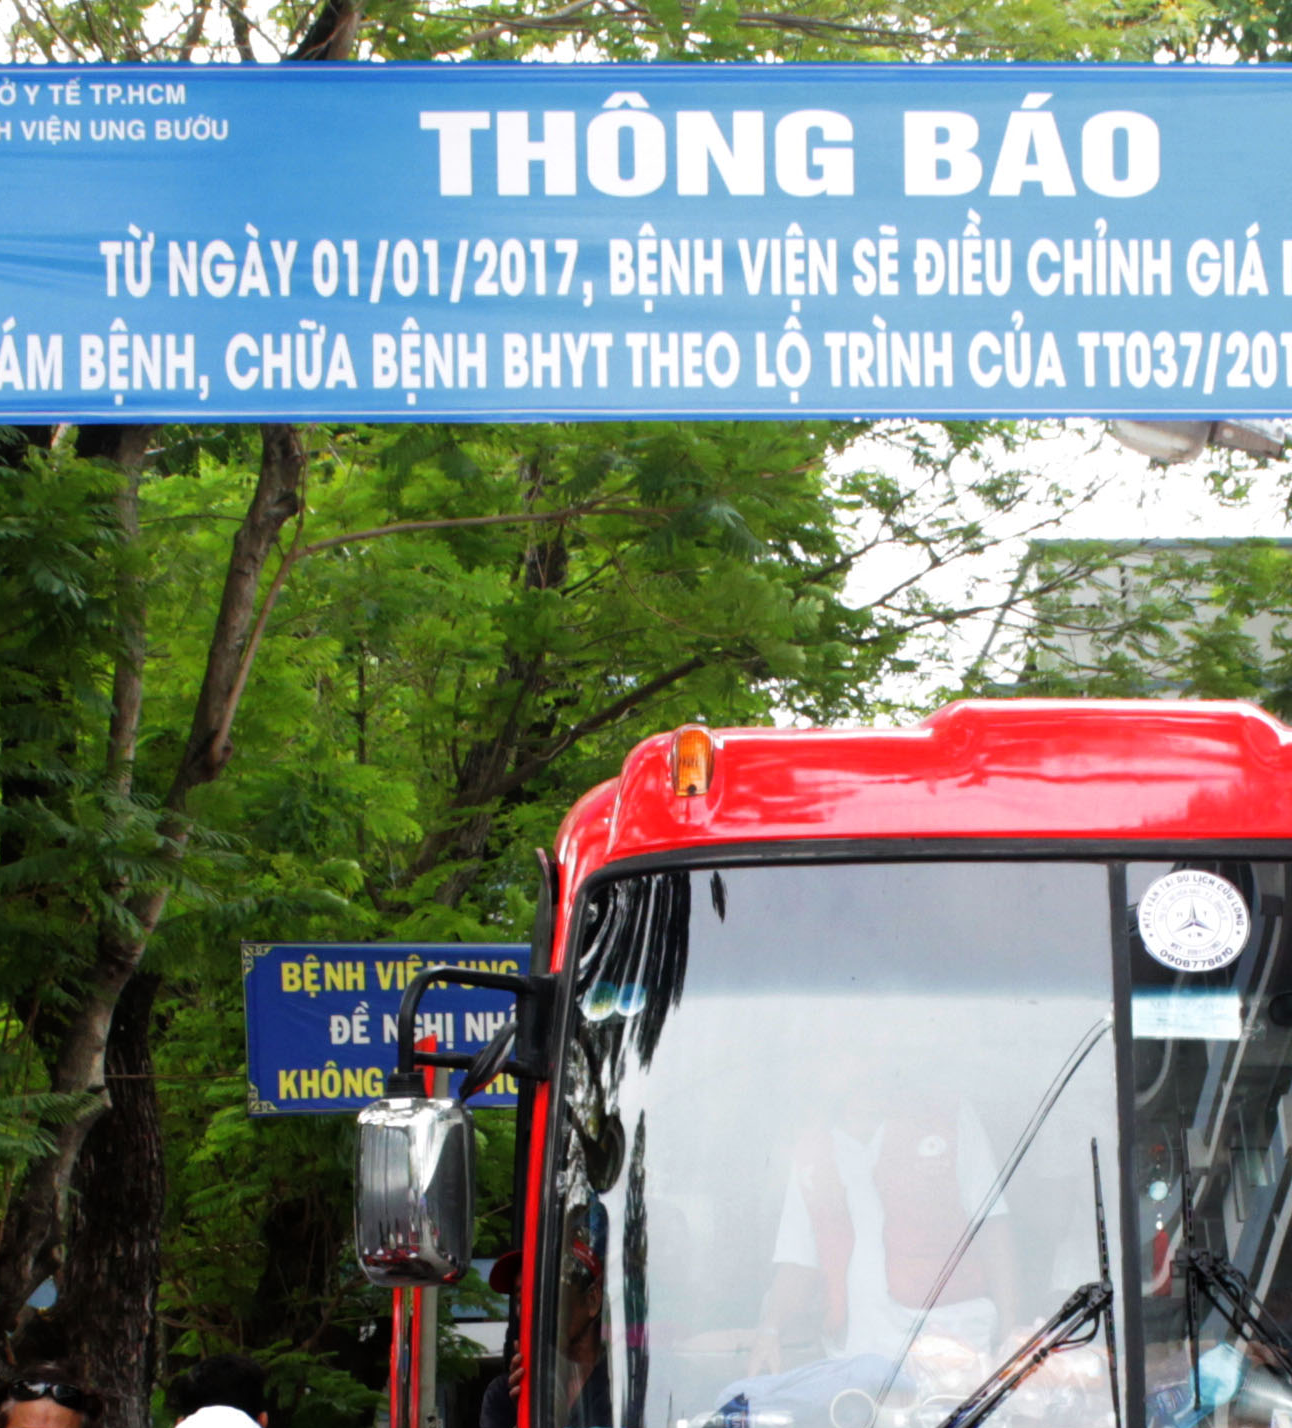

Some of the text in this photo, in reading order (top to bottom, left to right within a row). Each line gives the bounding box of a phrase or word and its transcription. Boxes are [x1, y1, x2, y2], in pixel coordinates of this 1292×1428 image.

[22, 85, 39, 105] Y
[44, 78, 81, 106] TẾ
[88, 83, 186, 105] TP.HCM
[20, 114, 82, 144] VIỆN
[89, 119, 148, 141] UNG
[154, 112, 229, 141] BƯỚU
[419, 91, 1161, 199] THÔNG BÁO
[99, 224, 155, 298] TỪ
[168, 223, 298, 298] NGÀY
[312, 238, 594, 308] 01/01/2017,
[608, 222, 724, 314] BỆNH
[737, 222, 839, 314] VIỆN
[851, 224, 901, 298] SẼ
[912, 209, 1013, 297] ĐIỀU
[1026, 218, 1171, 298] CHỈNH
[1185, 222, 1270, 298] GIÁ
[80, 318, 210, 405] BỆNH,
[224, 319, 357, 391] CHỮA
[372, 317, 488, 405] BỆNH
[502, 332, 614, 389] BHYT
[624, 331, 742, 389] THEO
[754, 315, 813, 405] LỘ
[823, 314, 955, 388] TRÌNH
[967, 310, 1068, 389] CỦA
[281, 954, 365, 998] BỆNH
[329, 1001, 371, 1045] ĐỀ
[278, 1061, 384, 1099] KHÔNG
